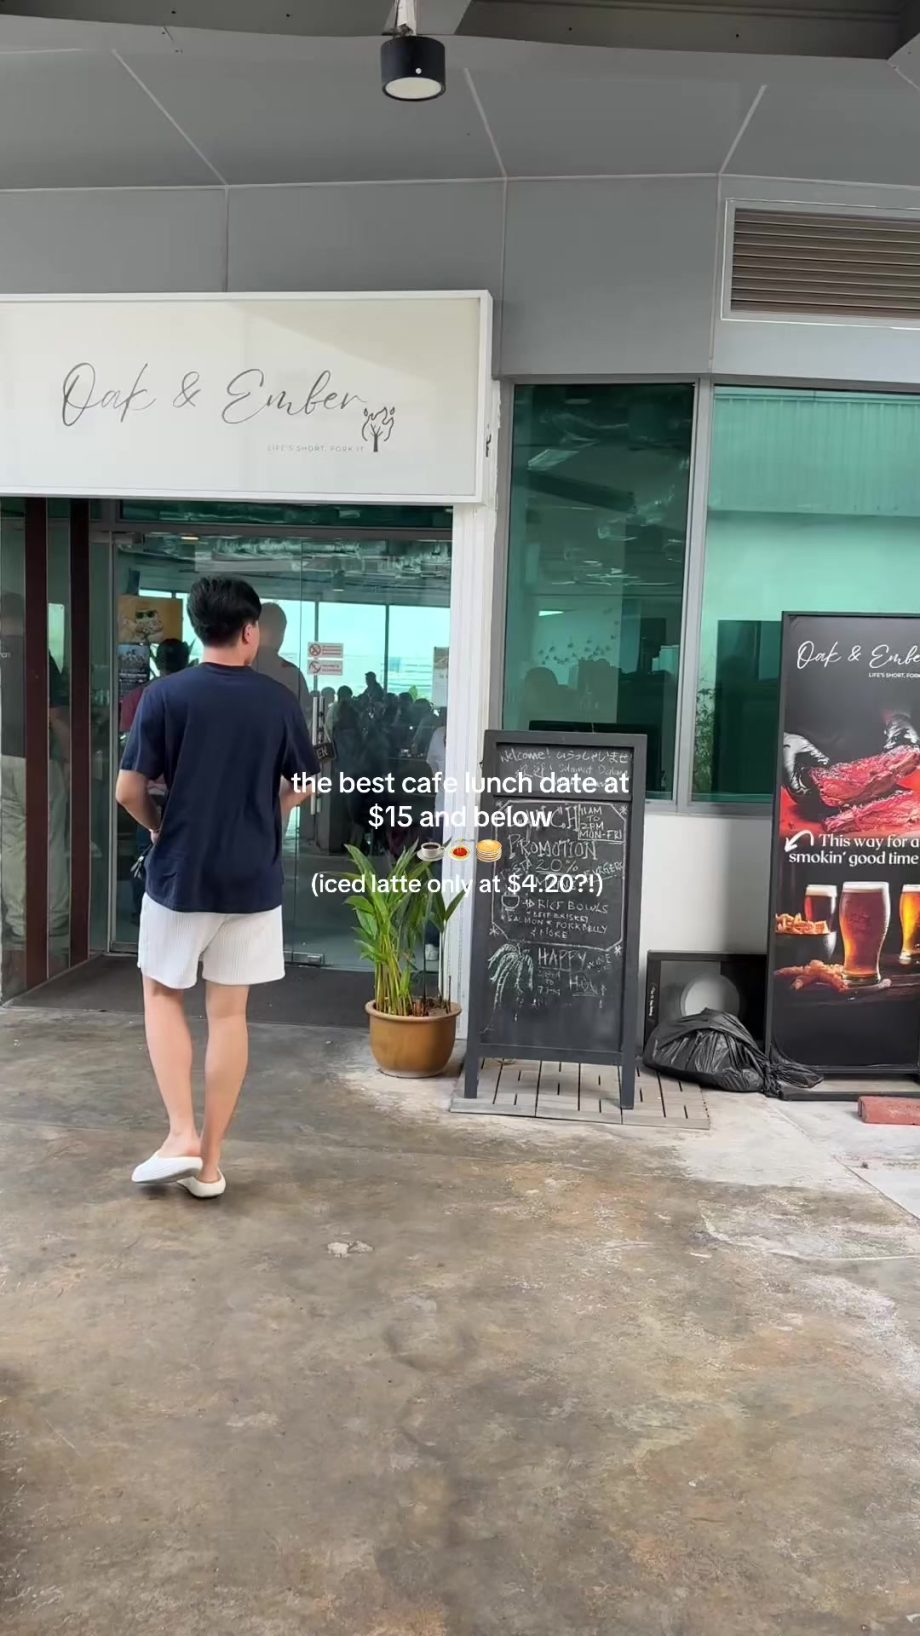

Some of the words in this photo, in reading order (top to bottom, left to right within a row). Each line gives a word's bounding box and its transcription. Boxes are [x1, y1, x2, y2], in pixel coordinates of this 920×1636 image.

[62, 362, 156, 426] Oak
[173, 371, 201, 408] &
[222, 368, 366, 425] Ember
[797, 640, 842, 669] Oak
[847, 645, 861, 661] &
[500, 747, 550, 763] Welcome!
[580, 830, 622, 839] MON-FRI
[581, 822, 604, 830] 2PM
[508, 834, 598, 860] PROMOTION
[819, 833, 850, 847] This
[854, 837, 884, 851] way
[887, 833, 908, 848] for
[910, 838, 920, 848] a
[789, 850, 846, 863] smokin'
[848, 851, 886, 867] good
[888, 851, 920, 864] time
[538, 899, 564, 911] RICE
[568, 900, 609, 914] BOWLS
[538, 947, 587, 970] HAPPY
